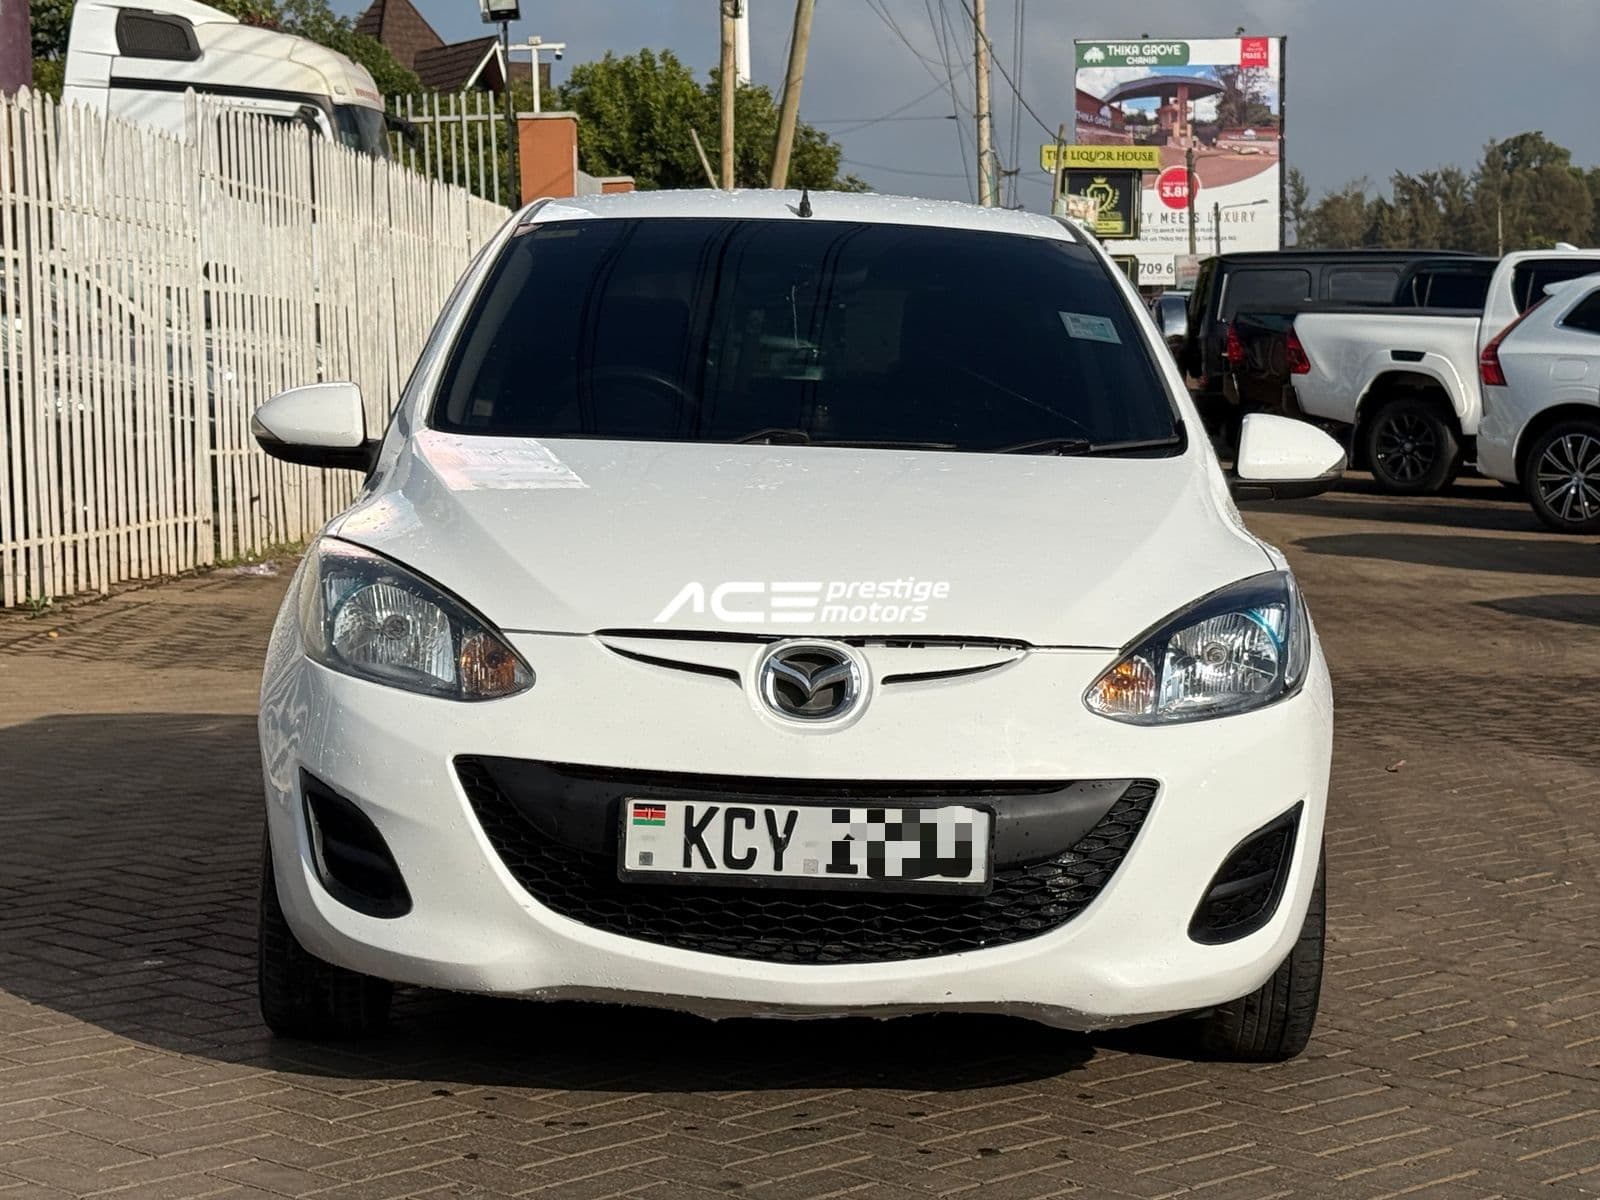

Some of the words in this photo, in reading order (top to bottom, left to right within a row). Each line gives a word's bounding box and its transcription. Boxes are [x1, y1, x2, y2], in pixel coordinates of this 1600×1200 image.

[1107, 44, 1140, 56] THIKA
[1142, 44, 1181, 56] GROVE
[1046, 150, 1067, 160] TE
[1071, 151, 1114, 162] LIQUOR
[1117, 151, 1155, 162] HOUSE
[1160, 212, 1200, 224] MEES
[1207, 211, 1256, 224] LXURY
[682, 804, 799, 872] KCY
